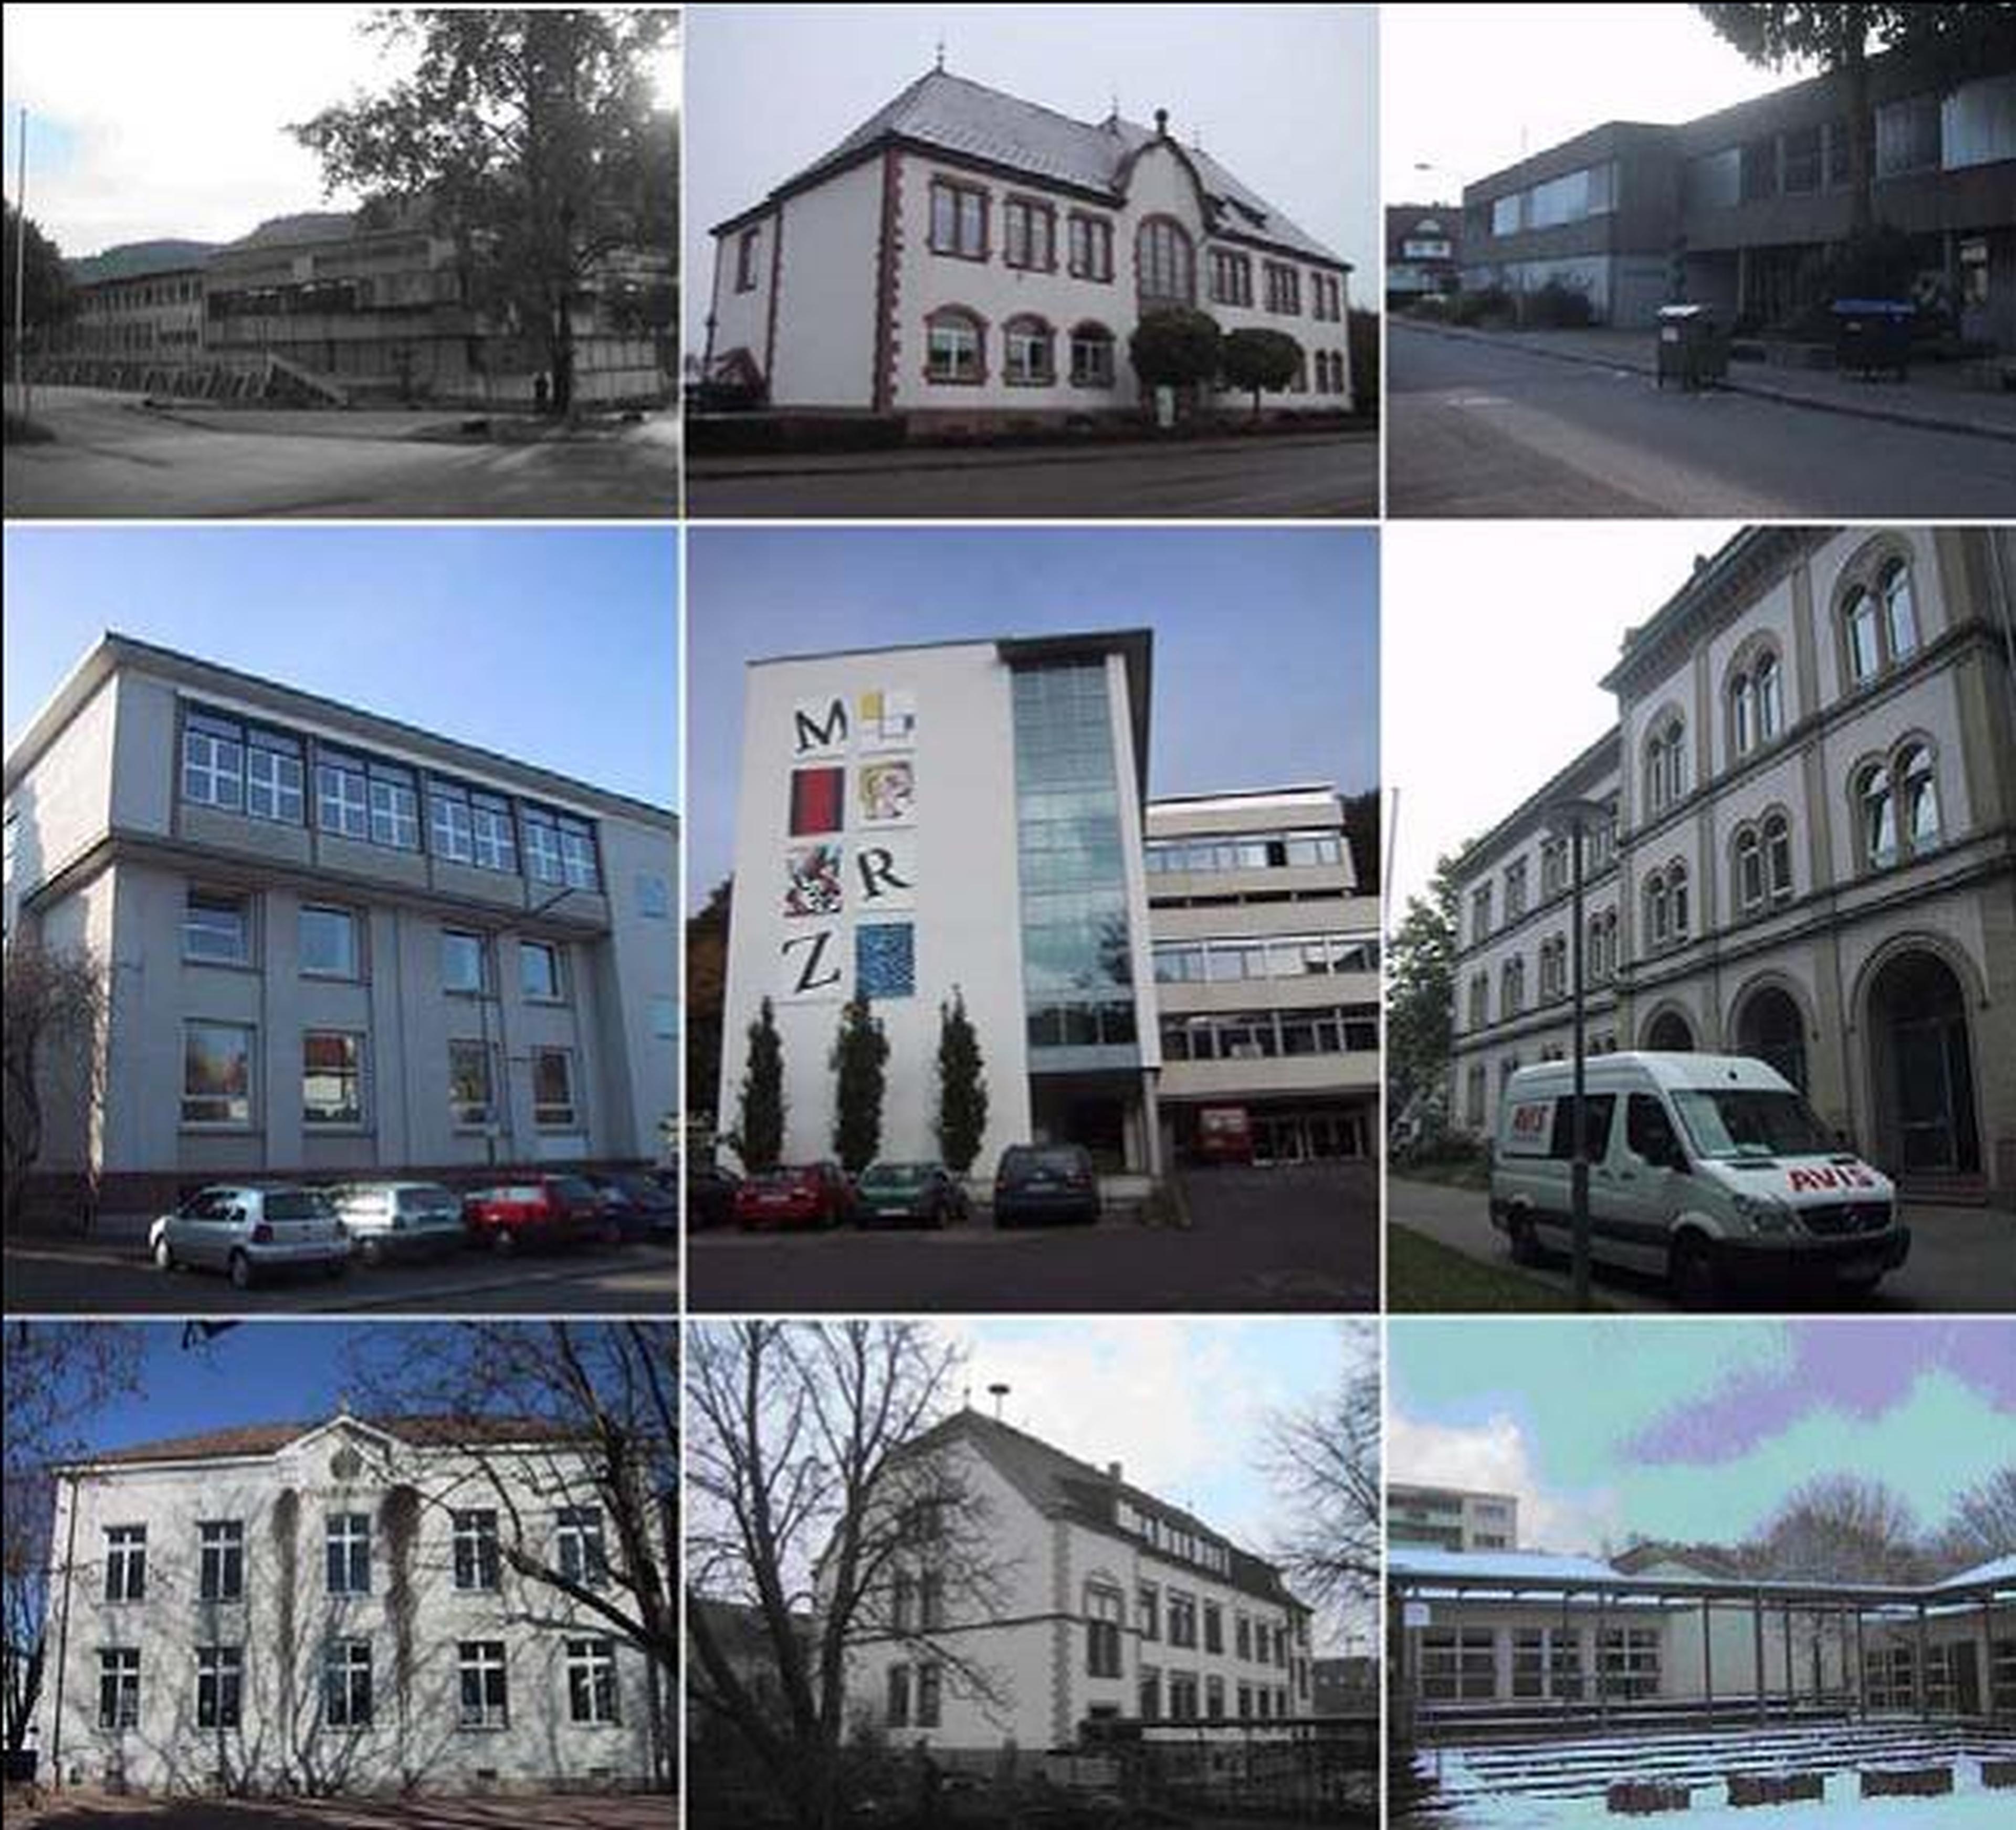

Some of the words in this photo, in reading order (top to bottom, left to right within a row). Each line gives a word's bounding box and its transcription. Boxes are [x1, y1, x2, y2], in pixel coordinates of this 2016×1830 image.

[794, 699, 847, 753] M
[857, 847, 915, 902] R
[782, 932, 839, 993] Z
[1789, 1168, 1874, 1192] AVIS
